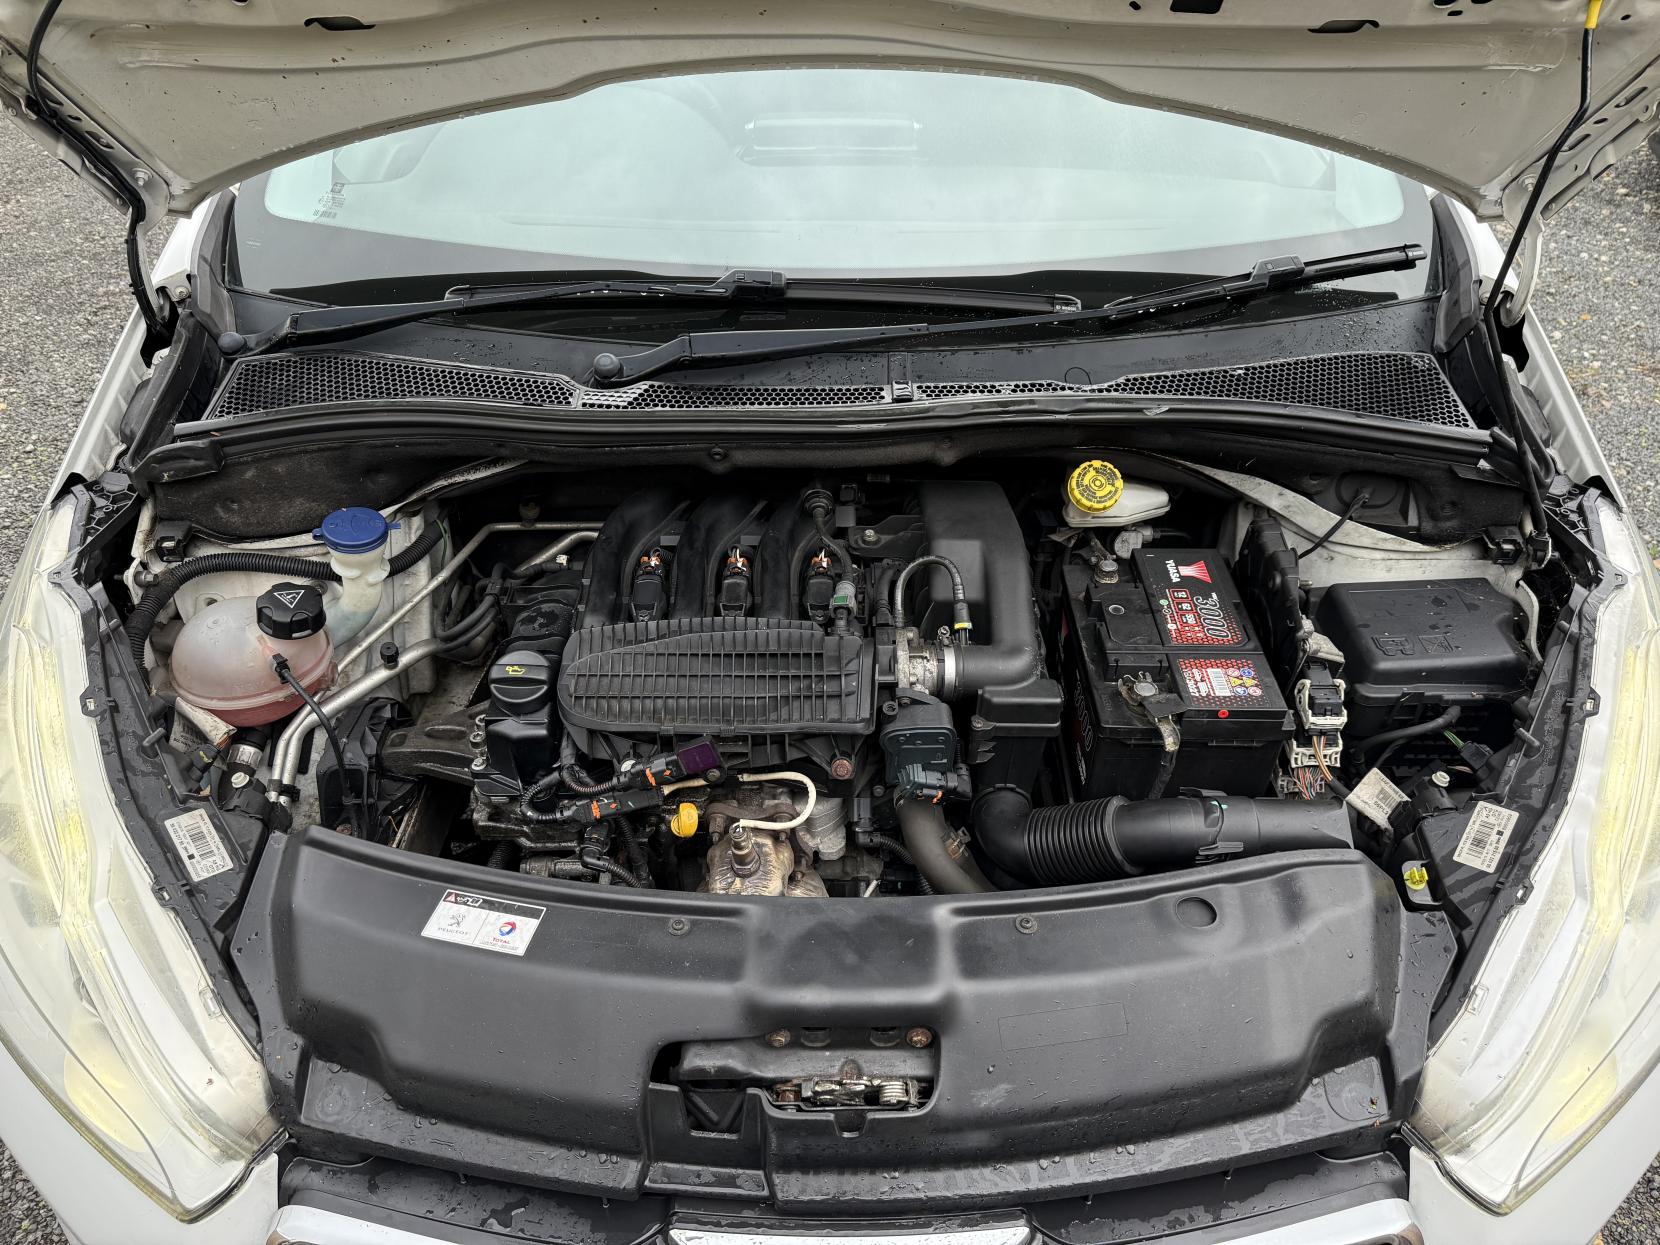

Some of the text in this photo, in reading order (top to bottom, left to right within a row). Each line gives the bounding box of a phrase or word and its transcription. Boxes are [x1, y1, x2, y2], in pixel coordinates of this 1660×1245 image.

[1165, 559, 1181, 583] YUASA
[1194, 596, 1231, 639] 3000
[493, 937, 510, 945] TOTAL
